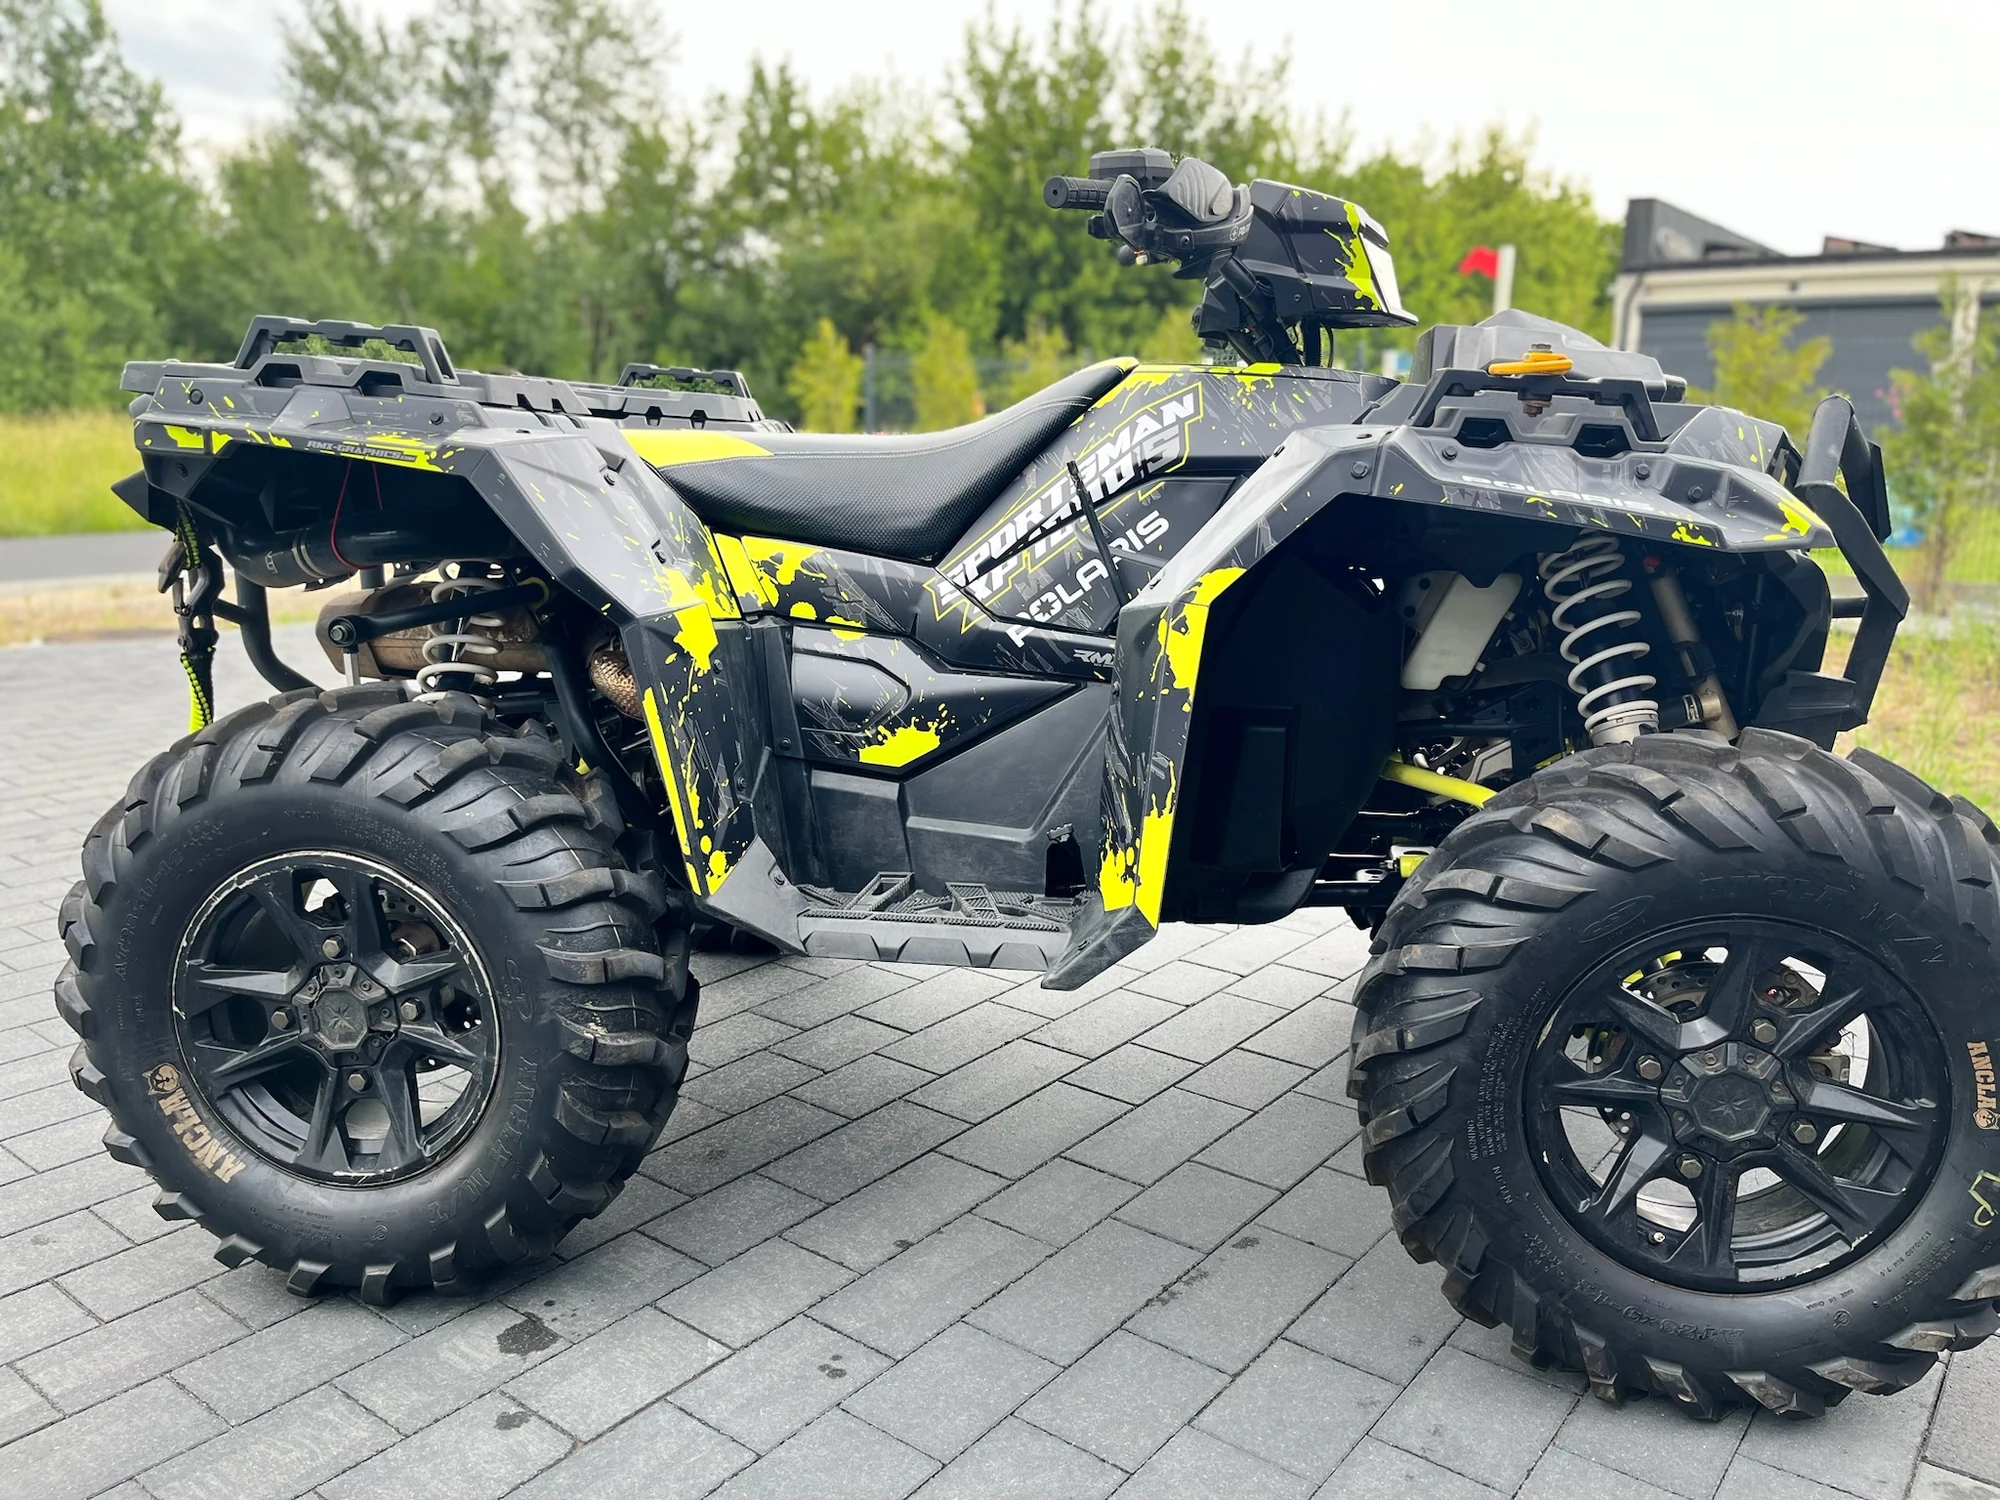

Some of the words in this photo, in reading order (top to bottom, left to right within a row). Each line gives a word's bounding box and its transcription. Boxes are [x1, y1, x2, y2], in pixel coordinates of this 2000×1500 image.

[936, 392, 1196, 606] SPORTSMAN
[1461, 474, 1655, 512] POLARIS
[1005, 509, 1170, 648] POLARIS
[1966, 1041, 1997, 1110] ANCLA
[157, 1087, 247, 1185] ANCLA
